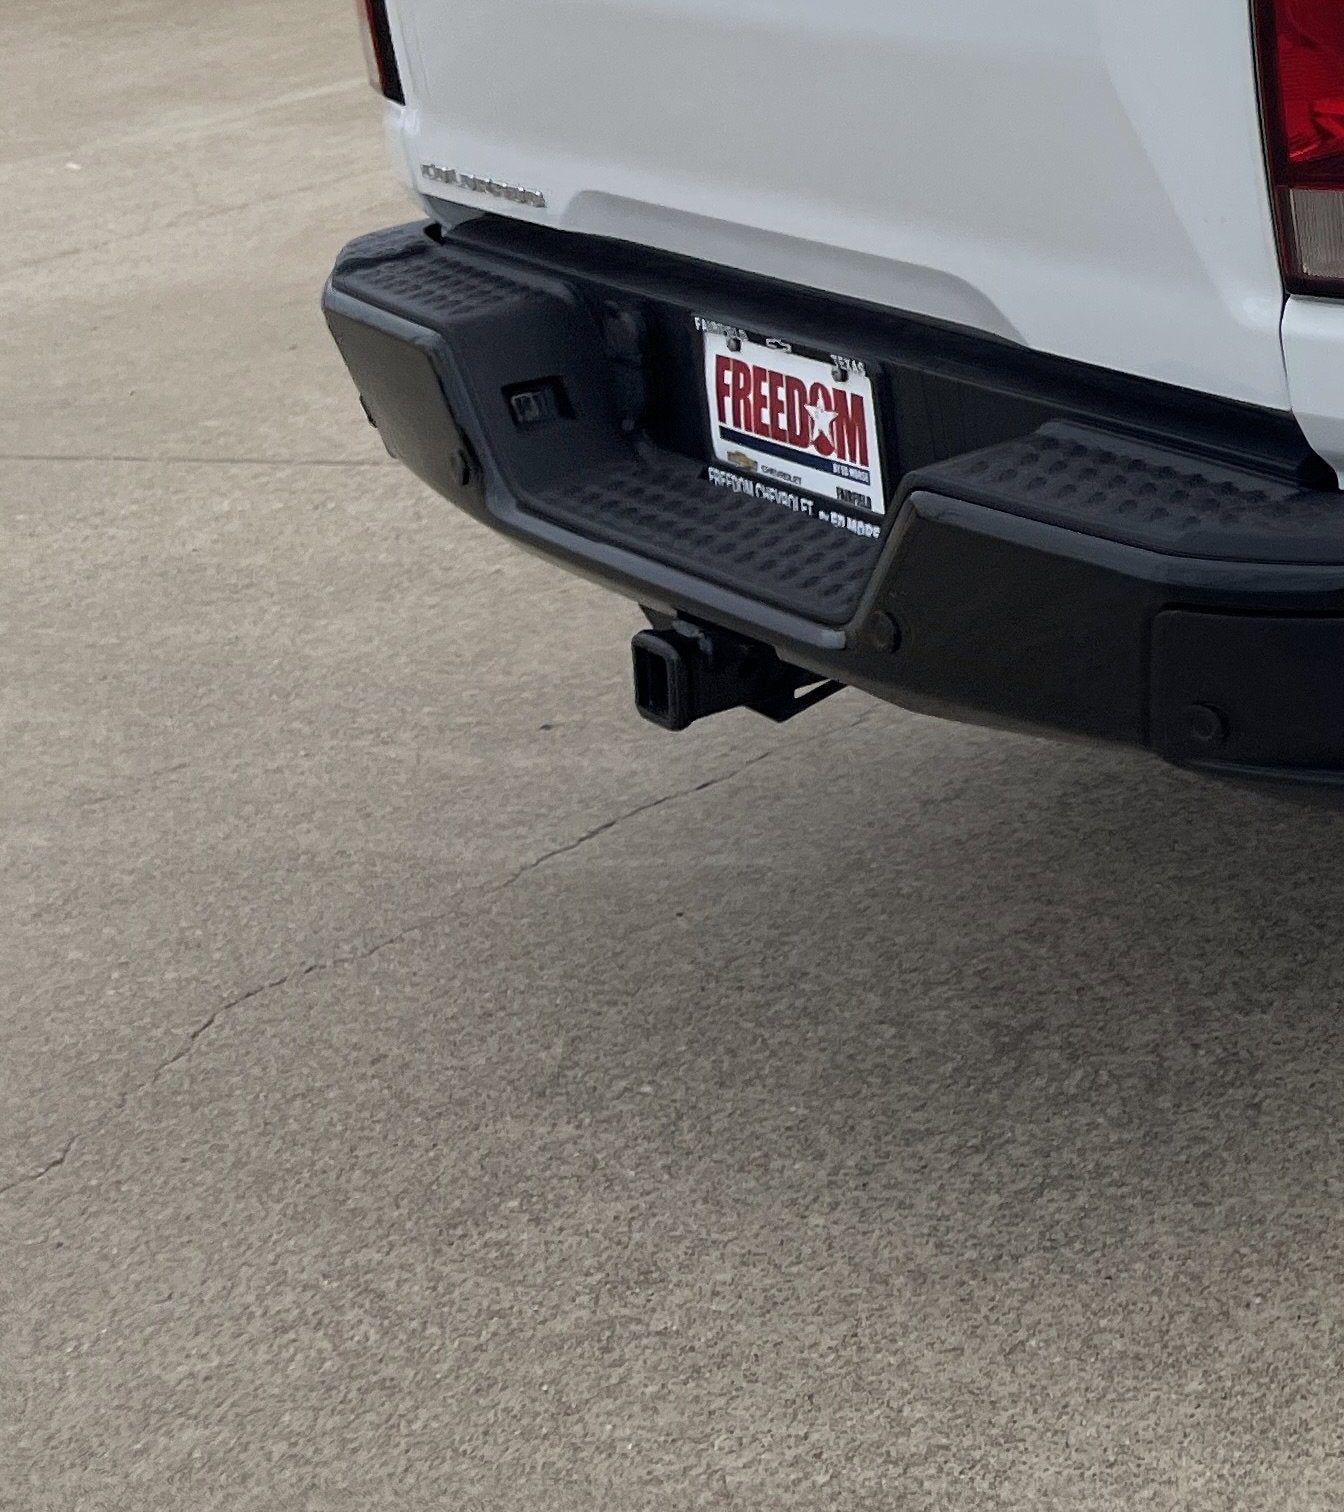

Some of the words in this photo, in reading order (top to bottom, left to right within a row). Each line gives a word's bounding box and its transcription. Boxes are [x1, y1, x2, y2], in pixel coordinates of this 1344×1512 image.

[830, 354, 866, 375] TEXAS
[715, 354, 869, 467] FREEDOM
[708, 467, 754, 496] FREEDOM
[755, 482, 813, 515] CHEVROLET
[847, 516, 880, 538] MORS
